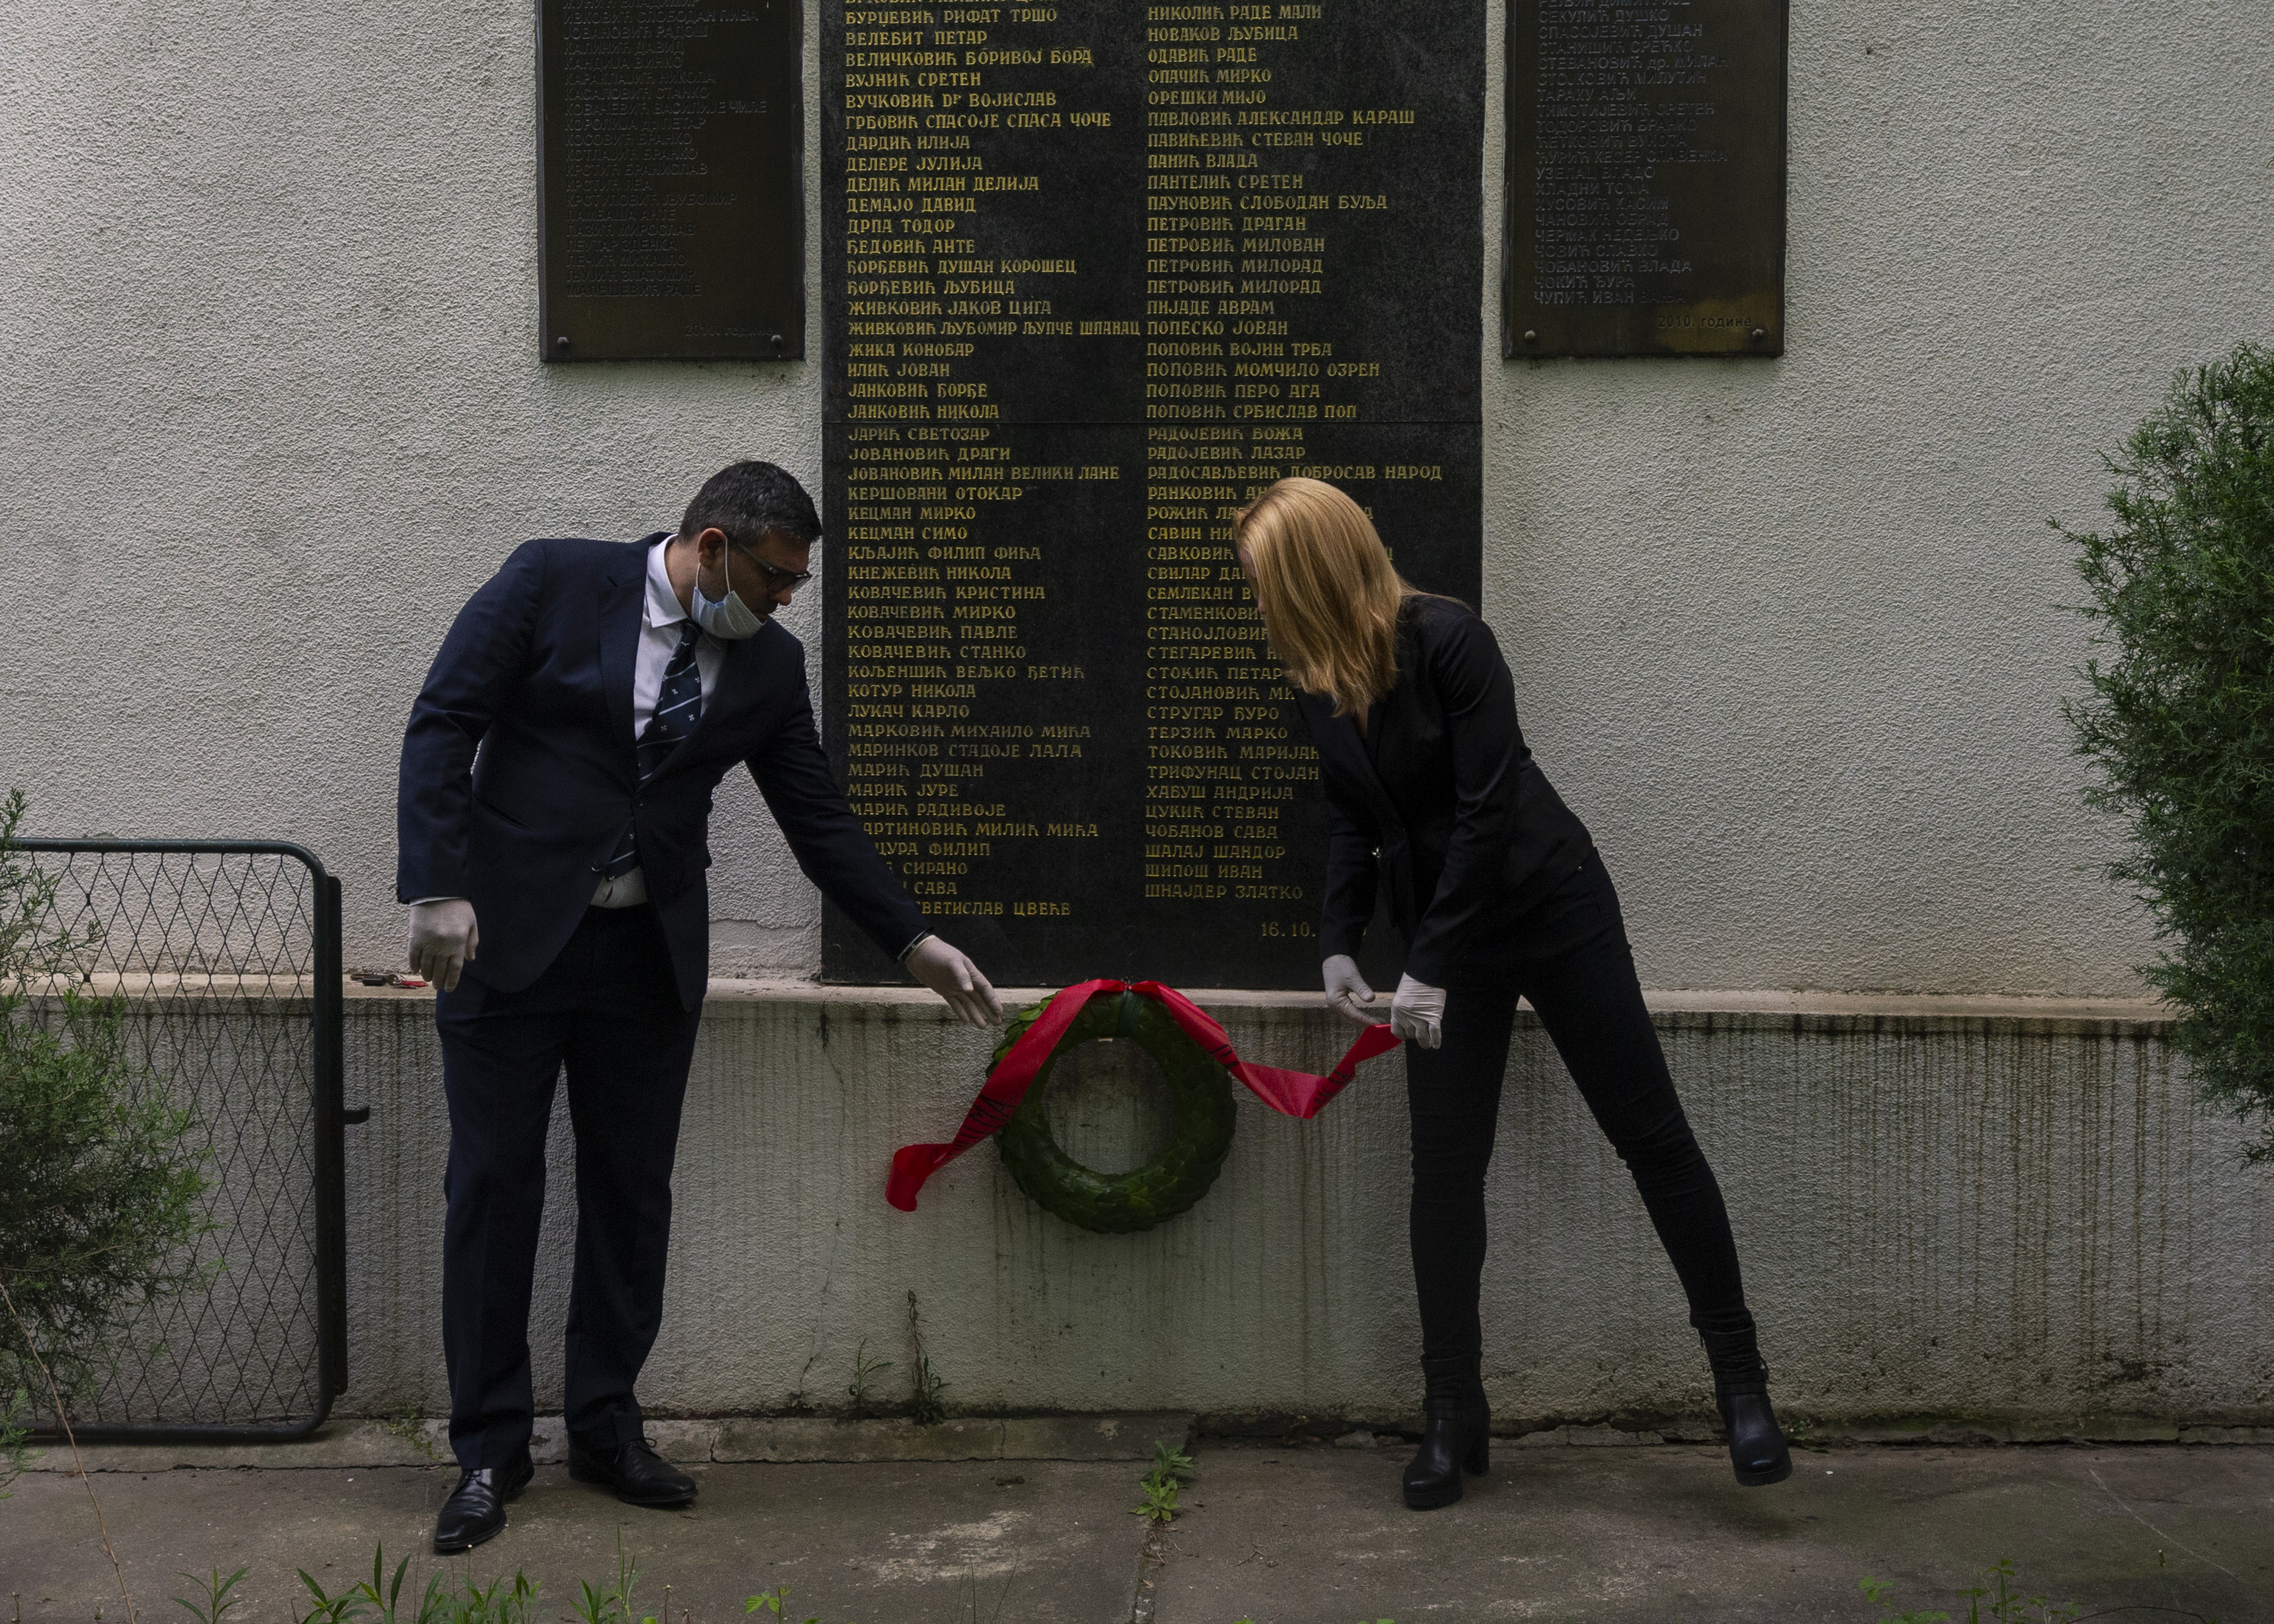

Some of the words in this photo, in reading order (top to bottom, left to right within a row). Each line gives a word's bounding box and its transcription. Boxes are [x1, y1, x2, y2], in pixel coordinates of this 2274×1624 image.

[563, 11, 633, 24] ИВКОВИЋ
[637, 10, 715, 24] СЛОБОДАН
[719, 9, 759, 22] ПИВА
[845, 10, 935, 25] БУРЏЕВИЋ
[944, 8, 1001, 23] РИФАТ
[1010, 8, 1058, 23] ТРШО
[1147, 5, 1225, 21] НИКОЛИЋ
[1229, 4, 1272, 21] РАДЕ
[1278, 4, 1321, 20] МАЛИ
[1538, 10, 1609, 23] СЕКУЛИЋ
[1614, 9, 1669, 23] ДУШКО
[563, 26, 652, 40] ЈОВАНОВИЋ
[656, 25, 707, 40] РАДОШ
[1148, 26, 1221, 42] НОВАКОВ
[1227, 25, 1299, 42] ЉУБИЦА
[1538, 25, 1642, 39] СПАСОЈЕВИЋ
[1647, 24, 1702, 39] ДУШАН
[564, 42, 632, 55] КАЛИНИЋ
[634, 41, 685, 56] ДАВИД
[1538, 41, 1625, 55] СТАНИШИЋ
[1630, 40, 1693, 53] СРЕЋКО
[845, 51, 958, 68] ВЕЛИЧКОВИЋ
[965, 50, 1044, 66] БОРИВОЈ
[1050, 49, 1093, 65] БОРА
[1538, 56, 1642, 69] СТЕВАНОВИЋ
[1148, 68, 1210, 84] ОПАЧИЋ
[1216, 68, 1272, 83] МИРКО
[565, 102, 650, 116] КОВАЧЕВИЋ
[654, 102, 726, 114] ВАСИЛИЈЕ
[729, 100, 767, 113] ЧИЛЕ
[845, 93, 935, 109] ВУЧКОВИЋ
[968, 92, 1057, 108] ВОЈИСЛАВ
[845, 114, 919, 130] ГРБОВИЋ
[925, 113, 1000, 129] СПАСОЈЕ
[1006, 112, 1062, 128] СПАСА
[1069, 112, 1112, 128] ЧОЧЕ
[1148, 111, 1232, 127] ПАВЛОВИЋ
[1236, 110, 1344, 126] АЛЕКСАНДАР
[1352, 109, 1415, 125] КАРАШ
[1536, 120, 1632, 135] ТОДОРОВИЋ
[1637, 119, 1698, 132] БРАНКО
[565, 133, 634, 146] КОСОВИЋ
[637, 133, 692, 145] БРАНКО
[1147, 133, 1244, 148] ПАВИЋЕВИЋ
[1251, 131, 1314, 147] СТЕВАН
[1320, 131, 1364, 146] ЧОЧЕ
[566, 164, 620, 177] КРСТИЋ
[624, 163, 708, 176] БРАНИСЛАВ
[845, 156, 909, 172] ДЕЛЕРЕ
[915, 156, 984, 171] ЈУЛИЈА
[1536, 167, 1596, 181] УЗЕЛАЦ
[1602, 166, 1656, 180] ВЛАДО
[845, 176, 901, 193] ДЕЛИЋ
[907, 176, 966, 192] МИЛАН
[972, 176, 1040, 193] ДЕЛИЈА
[1146, 195, 1233, 211] ПАУНОВИЋ
[1239, 195, 1330, 210] СЛОБОДАН
[1338, 195, 1388, 210] БУЉА
[846, 218, 893, 234] ДРПА
[900, 218, 956, 235] ТОДОР
[1146, 237, 1235, 253] ПЕТРОВИЋ
[1241, 238, 1325, 253] МИЛОВАН
[567, 255, 615, 267] ЛЕЧИЋ
[620, 254, 688, 267] МИХАЈЛО
[846, 259, 929, 275] ЂОРЂЕВИЋ
[937, 259, 994, 275] ДУШАН
[1000, 259, 1077, 274] КОРОШЕЦ
[1534, 260, 1633, 273] ЧОБАНОВИЋ
[1639, 259, 1692, 274] ВЛАДА
[567, 285, 660, 298] МАЛЕШЕВИЋ
[665, 284, 702, 298] РАДЕ
[1534, 291, 1587, 304] ЧУПИЋ
[1592, 291, 1634, 304] ИВАН
[848, 301, 942, 316] ЖИВКОВИЋ
[947, 300, 1002, 316] ЈАКОВ
[1008, 301, 1051, 315] ЦИГА
[1146, 299, 1210, 316] ПИЈАДЕ
[1218, 299, 1274, 315] АВРАМ
[848, 321, 937, 336] ЖИВКОВИЋ
[940, 321, 1018, 335] ЉУБОМИР
[1022, 321, 1073, 335] ЉУПЧЕ
[1079, 320, 1141, 336] ШПАНАЦ
[1700, 316, 1752, 328] године
[1146, 342, 1224, 356] ПОПОВИЋ
[1229, 342, 1284, 357] ВОЈИН
[1290, 342, 1332, 357] ТРБА
[1146, 362, 1227, 377] ПОПОВИЋ
[1233, 362, 1320, 377] МОМЧИЛО
[1326, 362, 1380, 377] ОЗРЕН
[848, 382, 929, 398] ЈАНКОВИЋ
[937, 383, 988, 399] ЂОРЂЕ
[1146, 404, 1226, 419] ПОПОВИЋ
[1233, 404, 1318, 419] СРБИСЛАВ
[1324, 404, 1357, 419] ПОП
[848, 427, 900, 442] ЈАРИЋ
[907, 427, 990, 441] СВЕТОЗАР
[1147, 446, 1243, 460] РАДОЈЕВИЋ
[1250, 445, 1306, 460] ЛАЗАР
[847, 466, 944, 481] ЈОВАНОВИЋ
[947, 466, 1004, 481] МИЛАН
[1010, 466, 1074, 480] ВЕЛИКИ
[1078, 466, 1120, 480] ЛАНЕ
[1147, 466, 1281, 480] РАДОСАВЉЕВИЋ
[1290, 466, 1376, 480] ДОБРОСАВ
[1385, 466, 1443, 481] НАРОД
[847, 506, 912, 520] КЕЦМАН
[919, 506, 977, 520] МИРКО
[848, 546, 920, 560] КЉАЈИЋ
[927, 546, 985, 560] ФИЛИП
[993, 546, 1041, 560] ФИЋА
[848, 586, 948, 599] КОВАЧЕВИЋ
[955, 586, 1045, 600] КРИСТИНА
[848, 644, 951, 659] КОВАЧЕВИЋ
[960, 645, 1026, 659] СТАНКО
[848, 665, 947, 678] КОЉЕНШИЋ
[956, 665, 1016, 678] ВЕЉКО
[1028, 665, 1084, 679] ЂЕТИЋ
[1146, 666, 1218, 680] СТОКИЋ
[1227, 666, 1285, 680] ПЕТАР
[1146, 706, 1224, 720] СТРУГАР
[1234, 706, 1279, 720] ЂУРО
[848, 724, 944, 737] МАРКОВИЋ
[950, 725, 1033, 737] МИХАИЛО
[1040, 725, 1090, 738] МИЋА
[1148, 726, 1217, 739] ТЕРЗИЋ
[1225, 726, 1288, 740] МАРКО
[848, 743, 937, 757] МАРИНКОВ
[949, 745, 1020, 757] СТАДОЈЕ
[1029, 744, 1081, 757] ЛАЛА
[1146, 785, 1206, 799] ХАБУШ
[1214, 786, 1292, 800] АНДРИЈА
[850, 802, 909, 816] МАРИЋ
[917, 803, 1006, 817] РАДИВОЈЕ
[1145, 805, 1205, 819] ЦУКИЋ
[1212, 805, 1279, 819] СТЕВАН
[1145, 844, 1204, 858] ШАЛАЈ
[1213, 845, 1285, 859] ШАНДОР
[1145, 884, 1227, 898] ШНАЈДЕР
[1235, 885, 1302, 899] ЗЛАТКО
[915, 901, 1004, 915] ВЕТИСЛАВ
[1013, 901, 1071, 917] ЦВЕЋЕ
